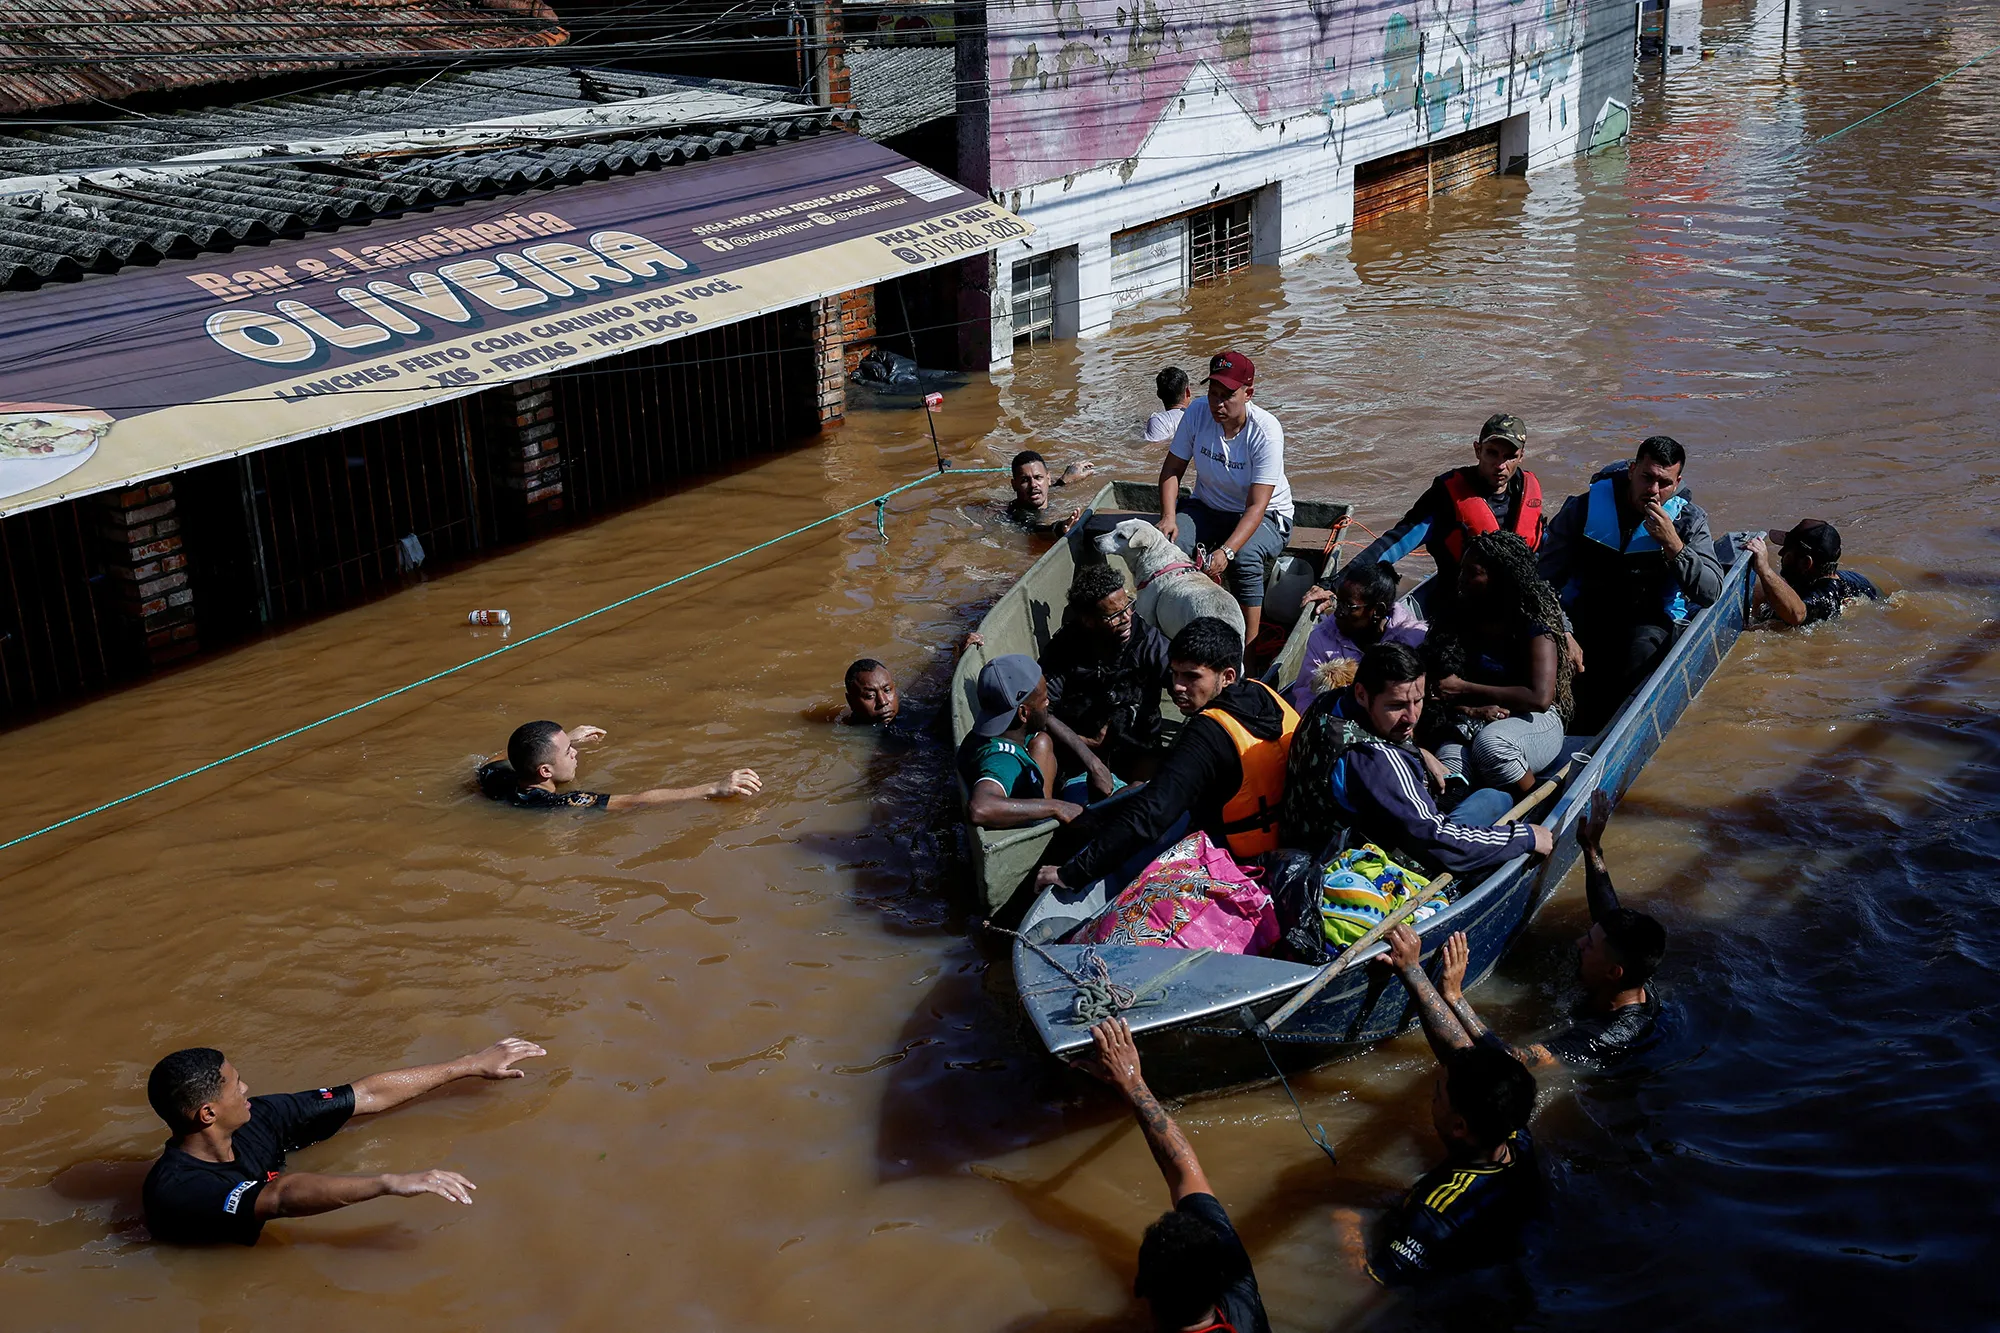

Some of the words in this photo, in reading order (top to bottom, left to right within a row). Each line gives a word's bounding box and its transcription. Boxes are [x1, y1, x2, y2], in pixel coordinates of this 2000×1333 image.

[692, 214, 763, 236] SIGA-NOS
[760, 206, 794, 220] NAS
[788, 196, 833, 212] REDES
[829, 184, 881, 202] SOCIAIS
[729, 220, 815, 247] @xisdovilmar
[875, 229, 925, 247] PEÇA
[919, 220, 946, 235] JÁ
[940, 218, 960, 229] O
[955, 208, 996, 225] SEU:
[186, 265, 304, 302] Bar
[328, 212, 578, 274] Lancheria
[205, 231, 688, 363] OLIVEIRA
[273, 364, 400, 404] LANCHES
[396, 347, 471, 373] FEITO
[471, 331, 534, 353] COM
[530, 305, 635, 339] CARINHO
[631, 294, 686, 314] PRA
[678, 278, 743, 302] VOCÊ.
[426, 366, 480, 390] XIS
[490, 340, 578, 373] FRITAS
[588, 322, 645, 348] HOT
[639, 310, 698, 334] DOG
[1390, 1239, 1429, 1269] RWAND
[1405, 1235, 1426, 1256] VISI
